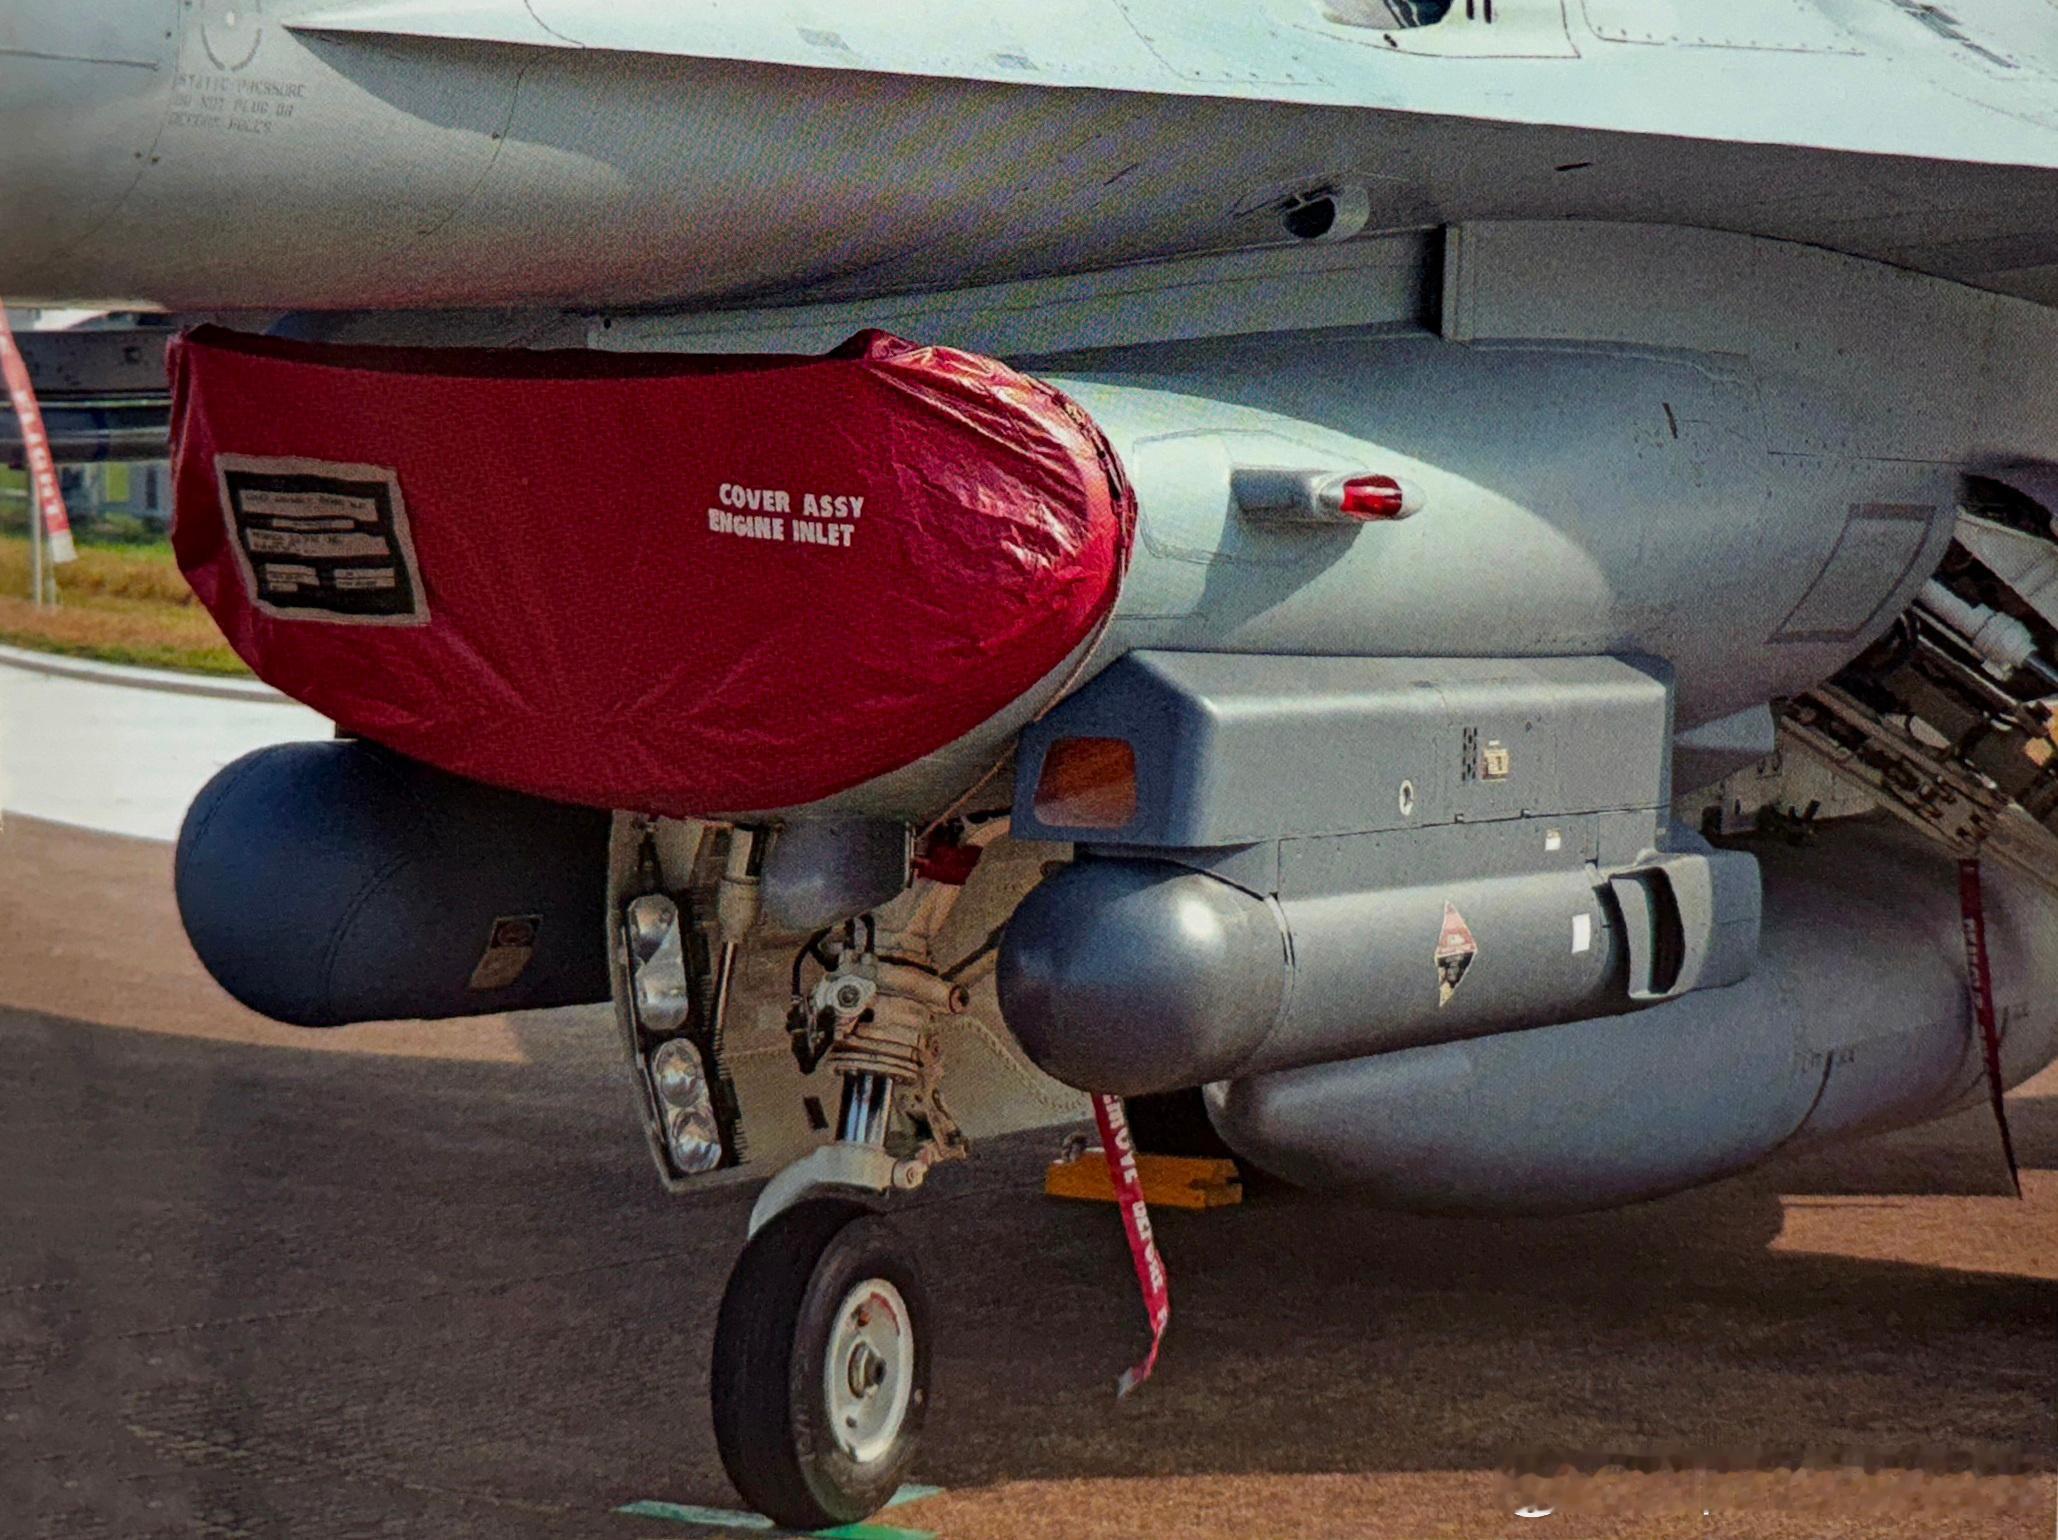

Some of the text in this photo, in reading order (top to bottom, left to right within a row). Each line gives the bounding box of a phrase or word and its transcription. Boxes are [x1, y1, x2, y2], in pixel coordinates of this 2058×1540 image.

[233, 98, 269, 114] PLUG
[719, 483, 864, 518] COVER ASSY
[708, 508, 855, 547] ENGINE INLET
